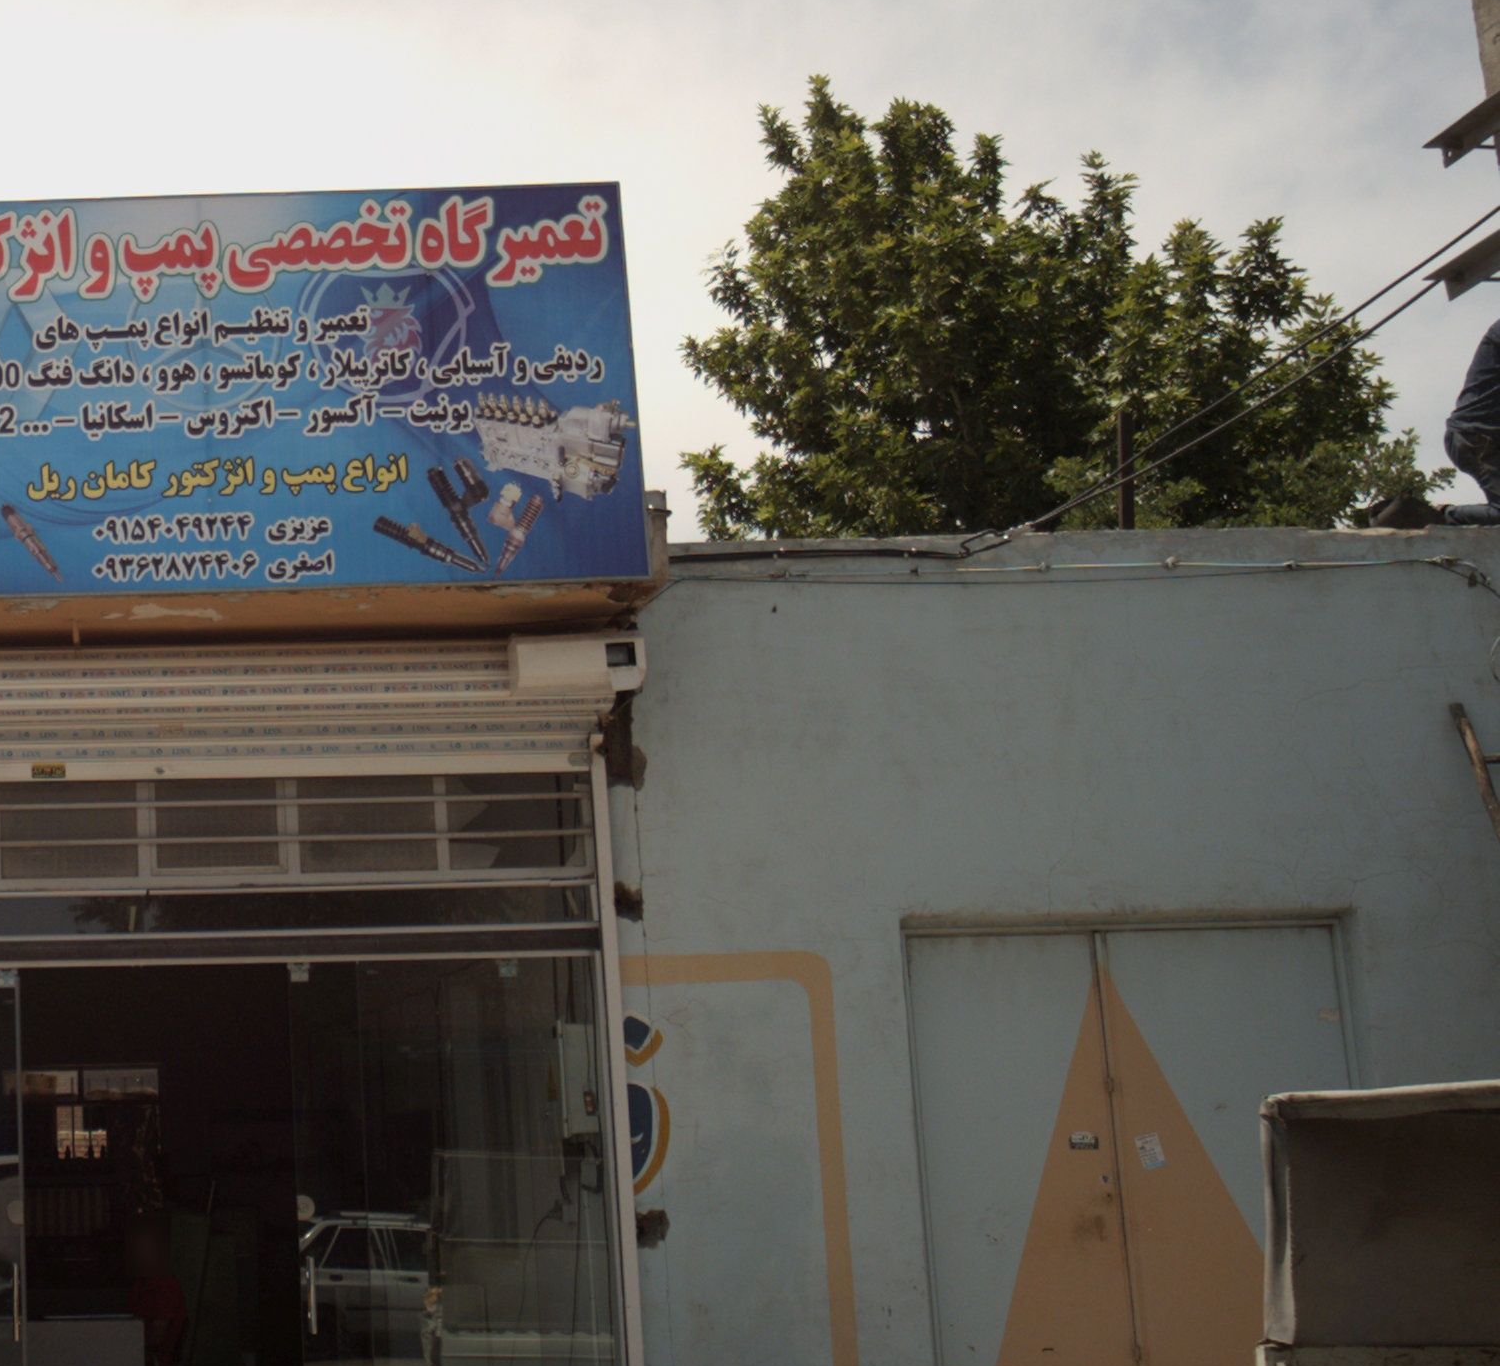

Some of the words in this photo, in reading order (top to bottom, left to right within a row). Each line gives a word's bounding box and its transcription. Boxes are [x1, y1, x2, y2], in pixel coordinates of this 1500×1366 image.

[122, 224, 218, 301] پمپ
[226, 200, 410, 290] تخصصی
[80, 233, 115, 299] و
[34, 315, 80, 351] های
[153, 312, 209, 348] انواع
[213, 306, 291, 344] تنظیم
[294, 315, 311, 343] و
[313, 306, 370, 343] تعمیر
[26, 357, 75, 389] فنگ
[77, 355, 137, 387] دانگ
[514, 356, 529, 383] و
[532, 347, 605, 384] ردیفی
[81, 402, 155, 441] اسکانیا
[184, 398, 275, 438] اکتروس
[305, 393, 380, 436] آکسور
[408, 396, 474, 434] یونیت
[25, 460, 77, 502] ریل
[81, 458, 158, 501] کامان
[258, 465, 278, 496] و
[280, 459, 338, 496] پمپ
[341, 452, 410, 494] انواع
[266, 515, 332, 544] عزیزی
[266, 550, 336, 581] اصغری
